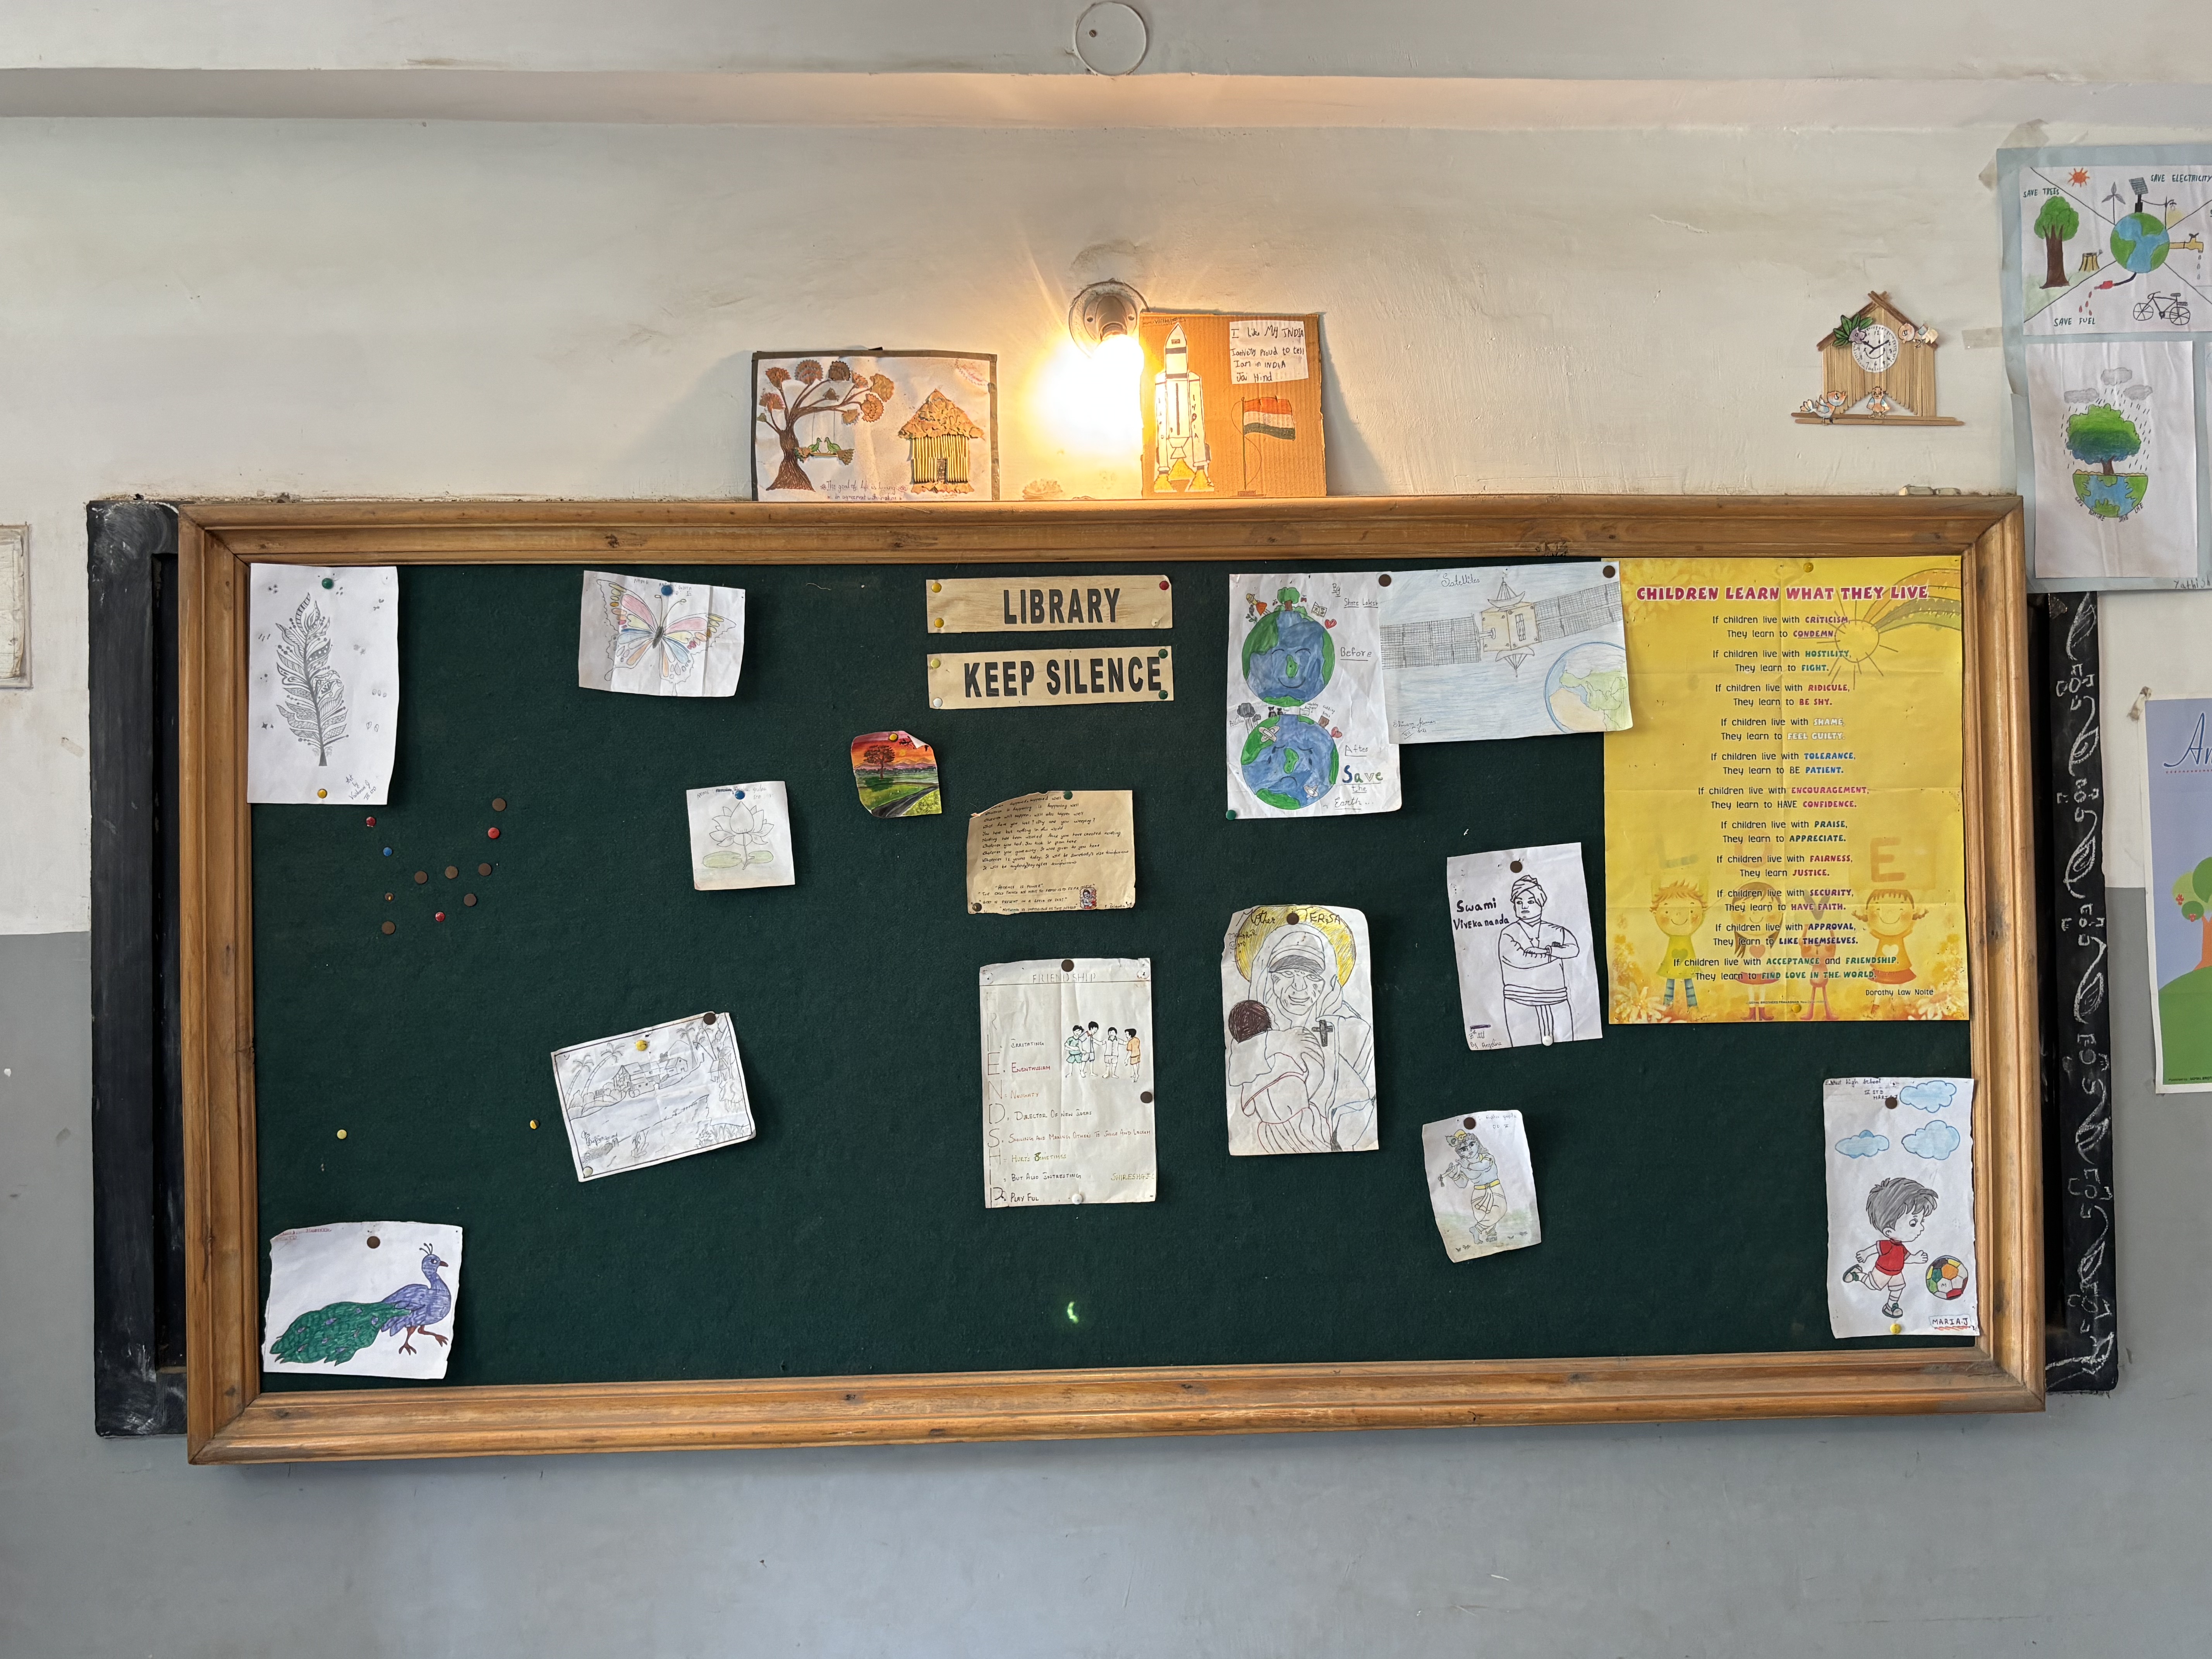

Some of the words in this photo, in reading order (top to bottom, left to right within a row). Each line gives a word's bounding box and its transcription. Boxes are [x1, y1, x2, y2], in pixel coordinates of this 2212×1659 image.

[2150, 174, 2166, 182] SAVE
[2172, 173, 2212, 182] ELECTRICITY
[2023, 189, 2039, 198] SAVE
[2042, 187, 2059, 196] TREES
[2054, 318, 2072, 326] SAVE
[2079, 317, 2096, 325] FUEL
[1282, 347, 1290, 356] to
[1293, 346, 1304, 355] tell
[1264, 360, 1286, 369] INDIA
[1237, 372, 1247, 382] Jai
[1254, 371, 1273, 383] Hind
[1331, 583, 1341, 596] By
[1636, 586, 1718, 601] CHILDREN
[1725, 586, 1780, 600] LEARN
[1786, 586, 1835, 600] WHAT
[1841, 586, 1884, 600] THEY
[1890, 584, 1929, 599] LIVE
[1003, 588, 1120, 625] LIBRARY
[1713, 615, 1719, 624] If
[1763, 616, 1778, 624] live
[1727, 630, 1747, 639] They
[1752, 629, 1774, 637] learn
[1340, 647, 1372, 658] Before
[1713, 650, 1719, 658] If
[1805, 649, 1851, 658] HOSTILITY,
[1735, 664, 1755, 673] They
[964, 660, 1035, 698] KEEP
[1046, 656, 1162, 696] SILENCE
[1721, 718, 1727, 726] If
[1731, 718, 1766, 726] children
[1771, 718, 1786, 726] live
[1790, 718, 1808, 726] with
[1721, 732, 1741, 742] They
[1747, 732, 1769, 740] learn
[1711, 752, 1717, 761] If
[1762, 752, 1776, 760] live
[1342, 765, 1383, 783] Save
[1723, 767, 1743, 776] They
[1352, 784, 1367, 792] the
[1721, 821, 1728, 829] If
[1771, 821, 1786, 829] live
[1722, 835, 1743, 844] They
[1717, 855, 1723, 863] If
[1740, 869, 1760, 878] They
[1456, 897, 1497, 913] Swami
[1236, 908, 1276, 926] Mother
[1674, 958, 1680, 967] If
[1684, 958, 1719, 966] children
[1724, 958, 1739, 966] live
[1766, 958, 1820, 966] ACCEPTANCE
[1825, 957, 1841, 965] and
[1845, 957, 1899, 966] FRIENDSHIP,
[1695, 972, 1716, 982] They
